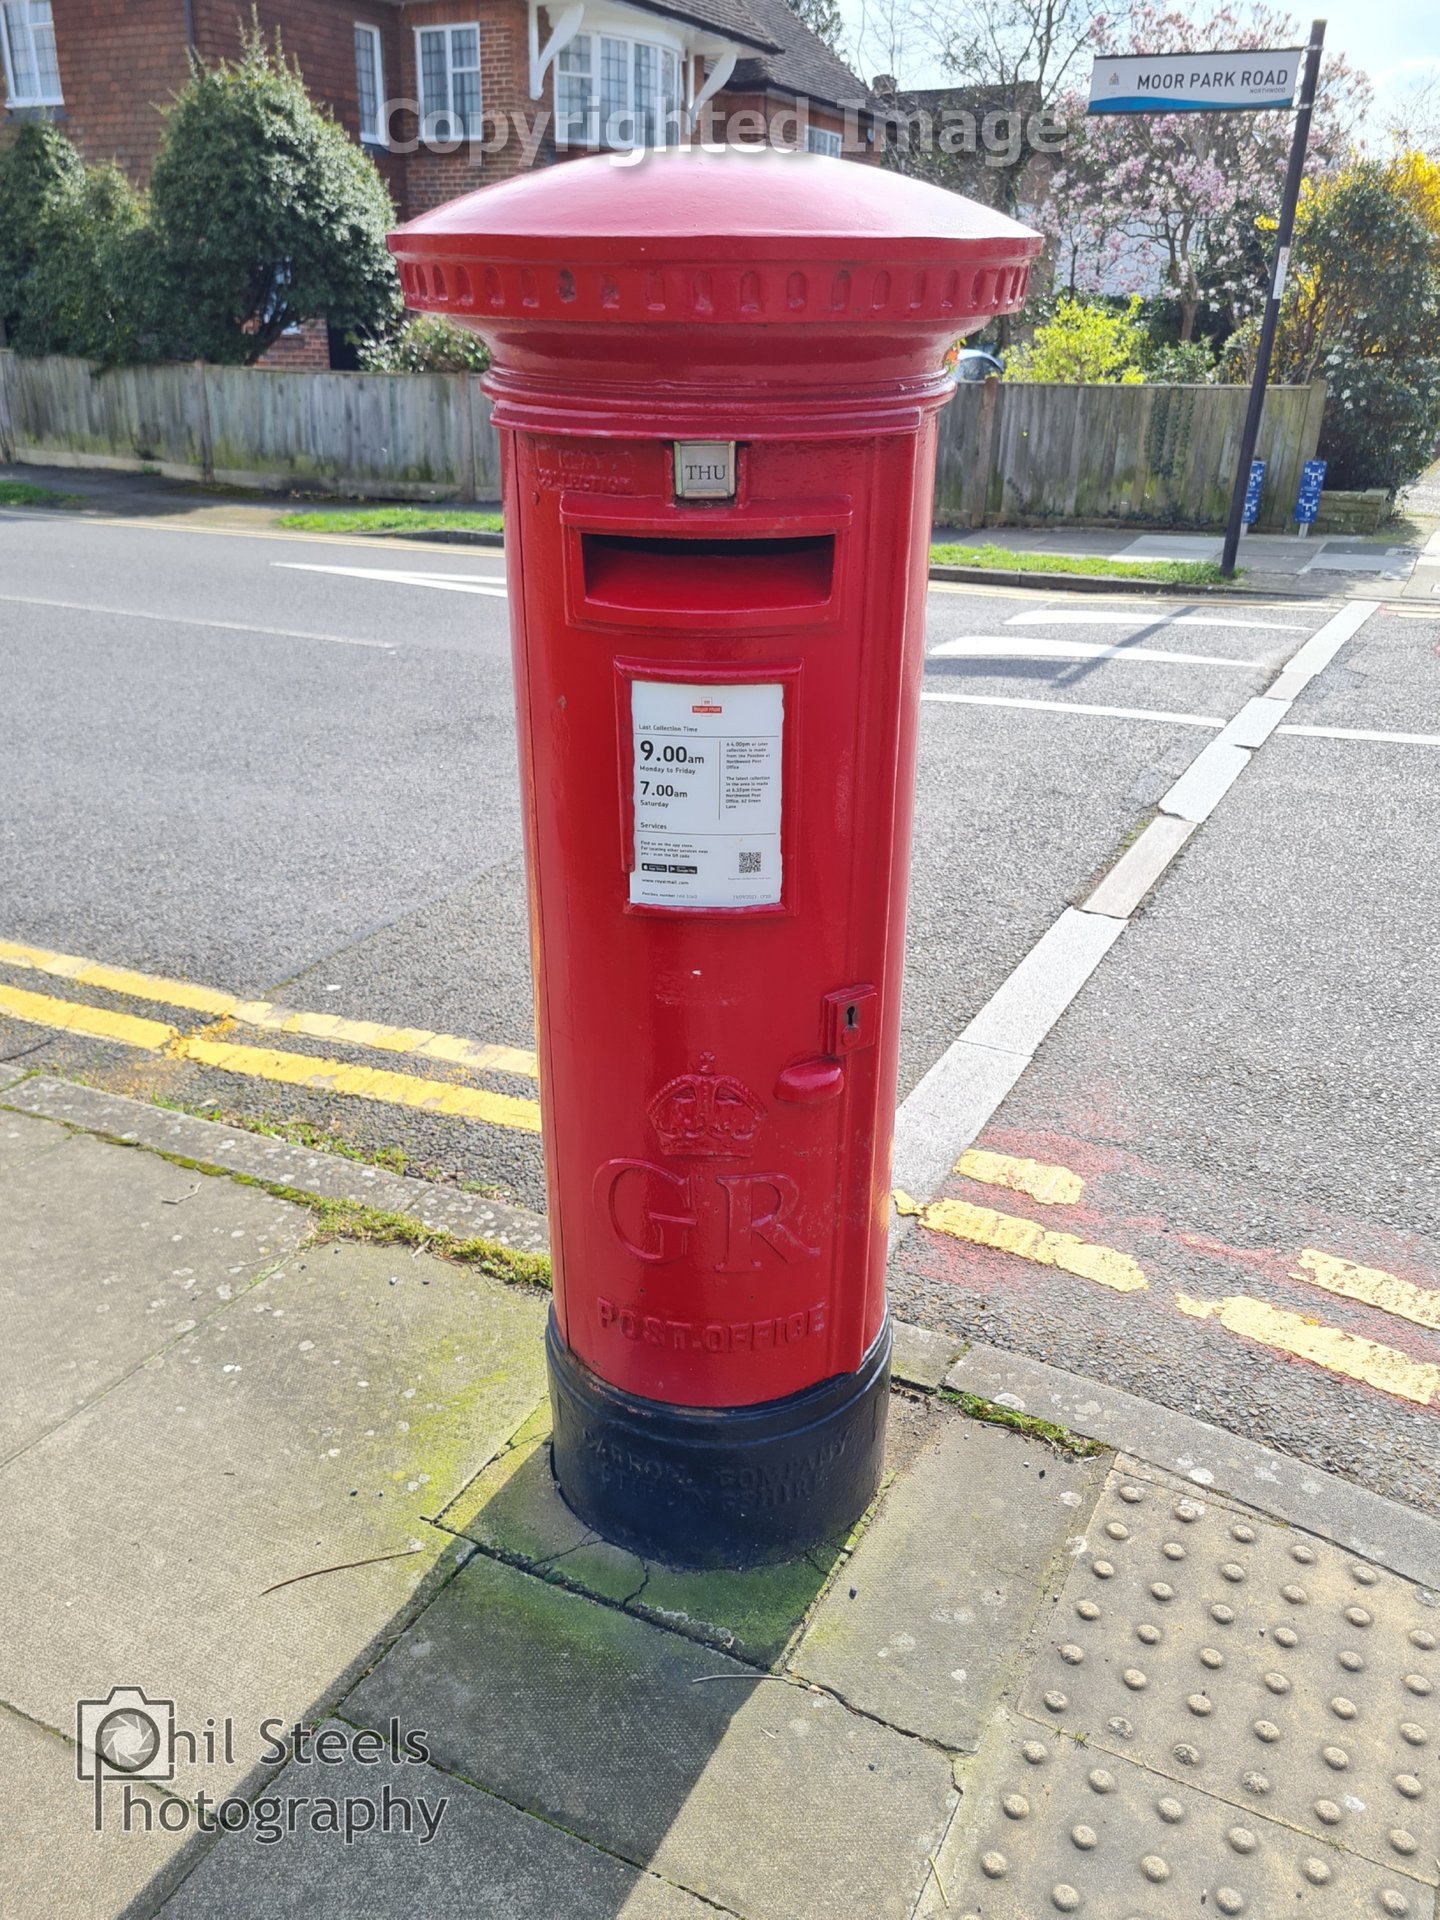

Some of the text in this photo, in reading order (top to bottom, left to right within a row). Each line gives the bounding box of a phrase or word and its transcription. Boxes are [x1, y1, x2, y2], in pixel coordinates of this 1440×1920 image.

[1137, 73, 1185, 90] MOOR
[1190, 71, 1237, 88] PARK
[1240, 69, 1288, 87] ROAD
[1249, 87, 1286, 95] NORTHWOOD
[684, 464, 727, 481] THU
[639, 740, 705, 764] 9.00am
[639, 764, 665, 774] Monday
[675, 767, 696, 775] Friday
[639, 780, 688, 798] 7.00am
[640, 799, 669, 809] Saturday
[640, 822, 667, 830] Services
